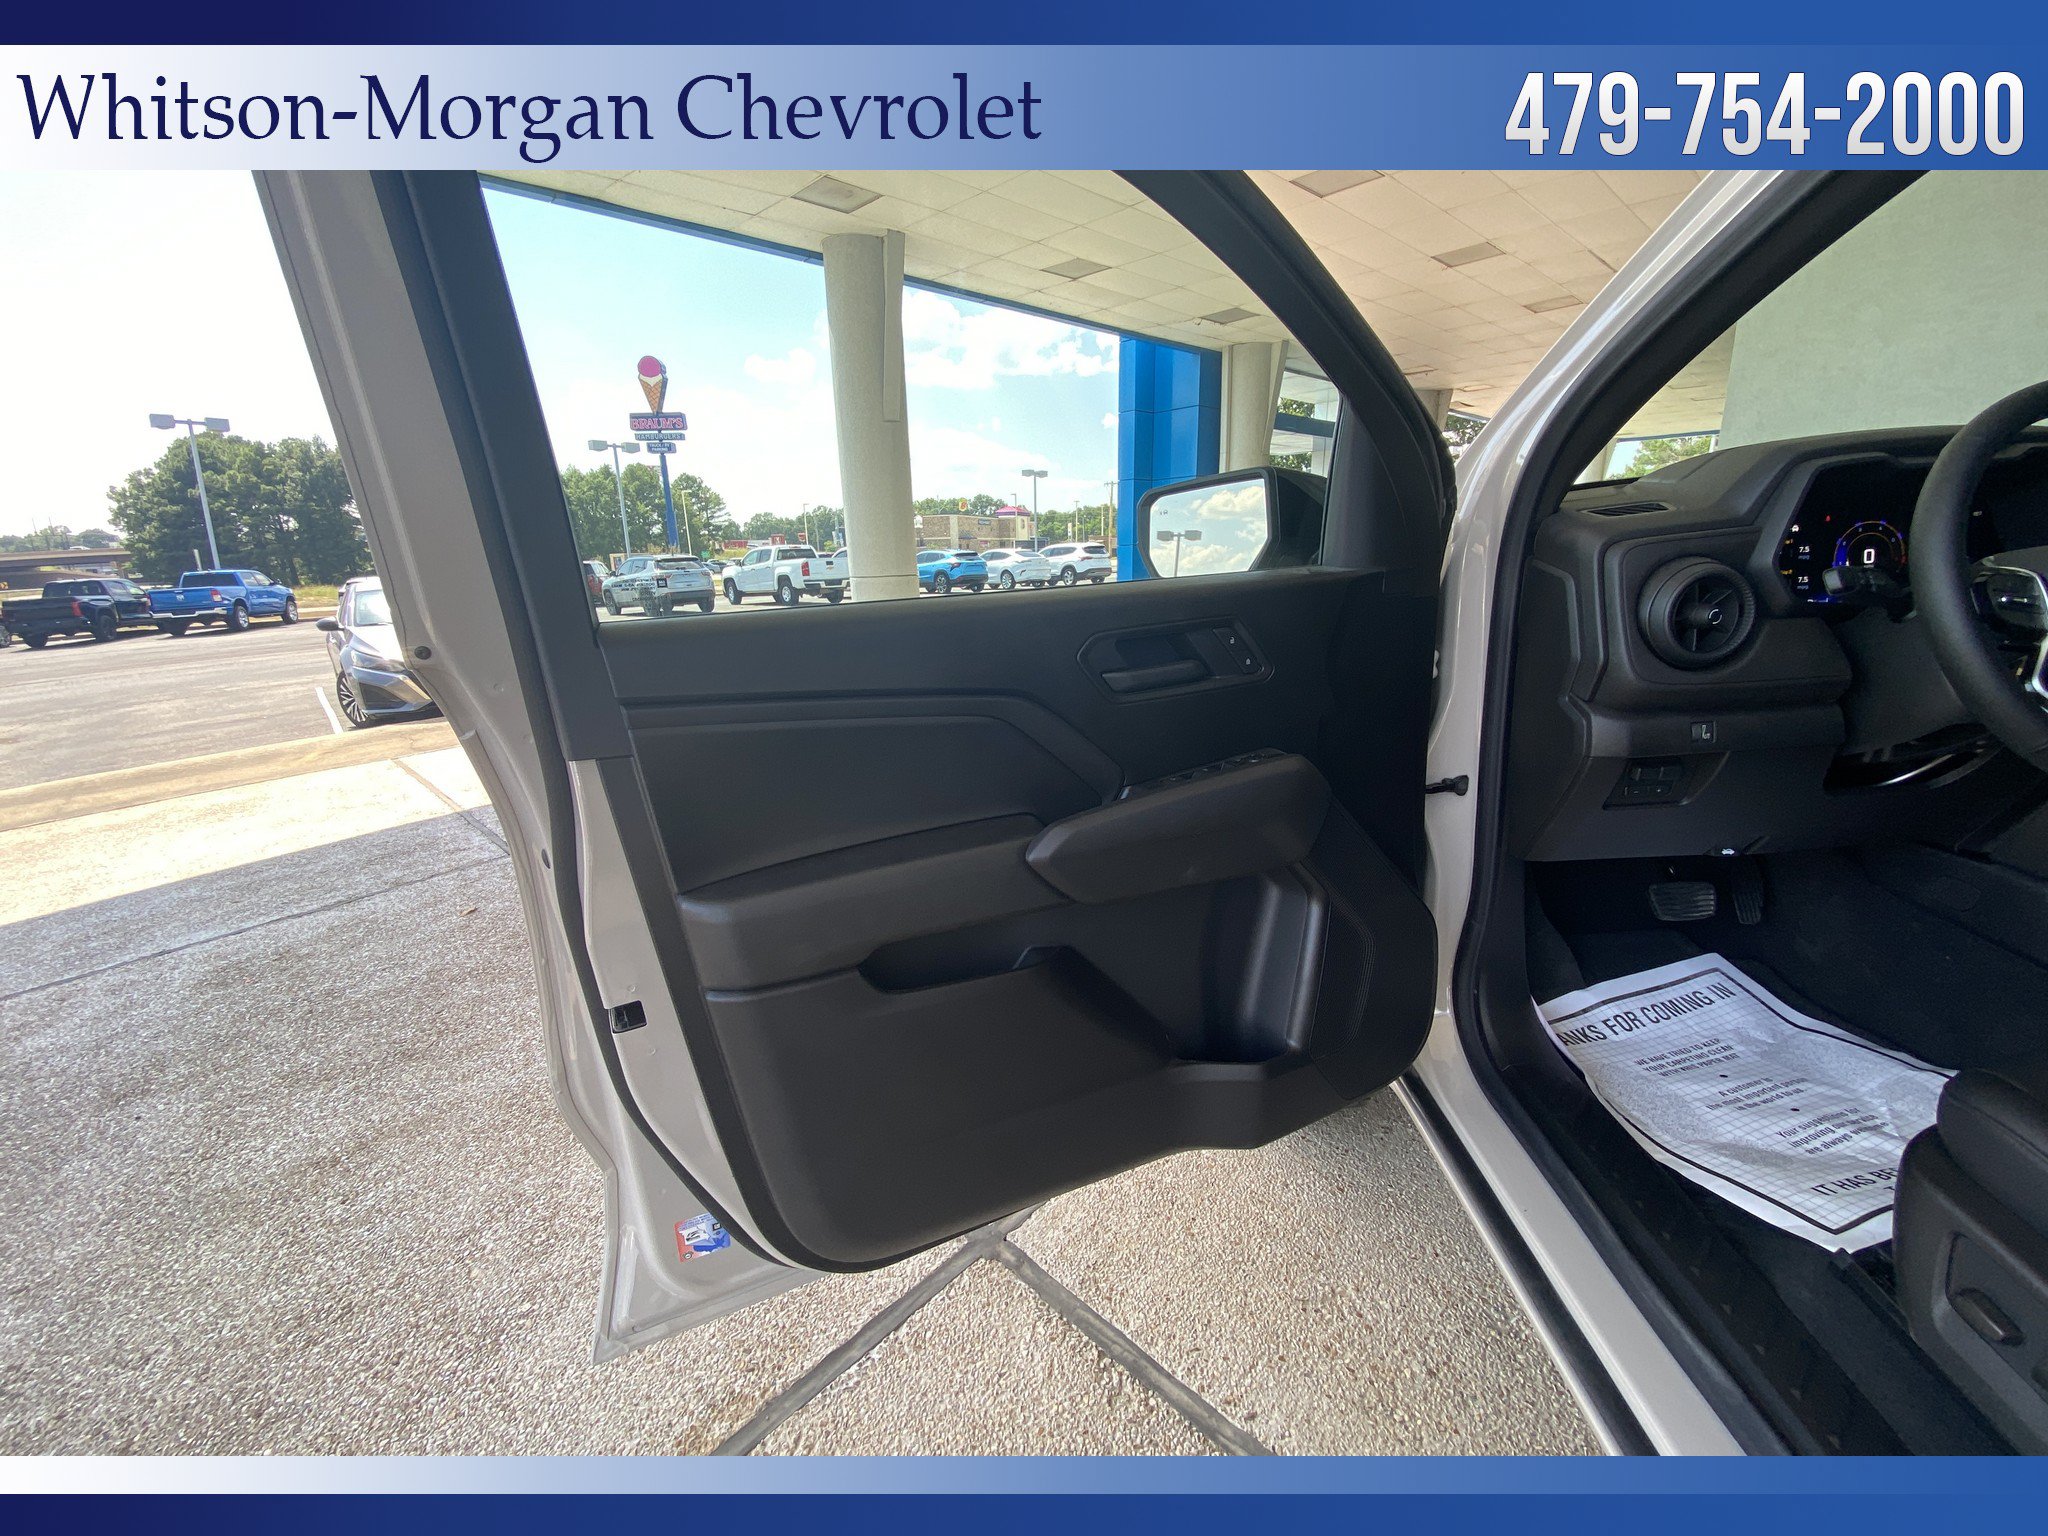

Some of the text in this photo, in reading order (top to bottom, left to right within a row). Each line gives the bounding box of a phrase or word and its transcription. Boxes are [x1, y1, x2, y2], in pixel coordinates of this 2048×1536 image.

[632, 417, 684, 430] BRAUM'S
[1863, 548, 1875, 564] 0
[1555, 982, 1737, 1047] ANKS FOR COMING IN
[1634, 1057, 1650, 1065] WE
[1648, 1053, 1670, 1063] HAVE
[1669, 1046, 1692, 1057] TRIED
[1701, 1038, 1721, 1047] KEEP
[1643, 1044, 1735, 1072] YOUR CARPETING CLEAN
[1658, 1068, 1682, 1076] WITH
[1698, 1057, 1724, 1069] PAPER
[1722, 1052, 1742, 1061] MAT
[1706, 1102, 1723, 1110] the
[1722, 1096, 1745, 1105] most
[1744, 1083, 1784, 1100] important
[1727, 1079, 1763, 1094] customer
[1760, 1093, 1784, 1104] world
[1777, 1127, 1800, 1138] Your
[1788, 1126, 1836, 1148] improving
[1806, 1146, 1823, 1154] are
[1821, 1132, 1853, 1150] always
[1809, 1166, 1899, 1196] IT HAS BE
